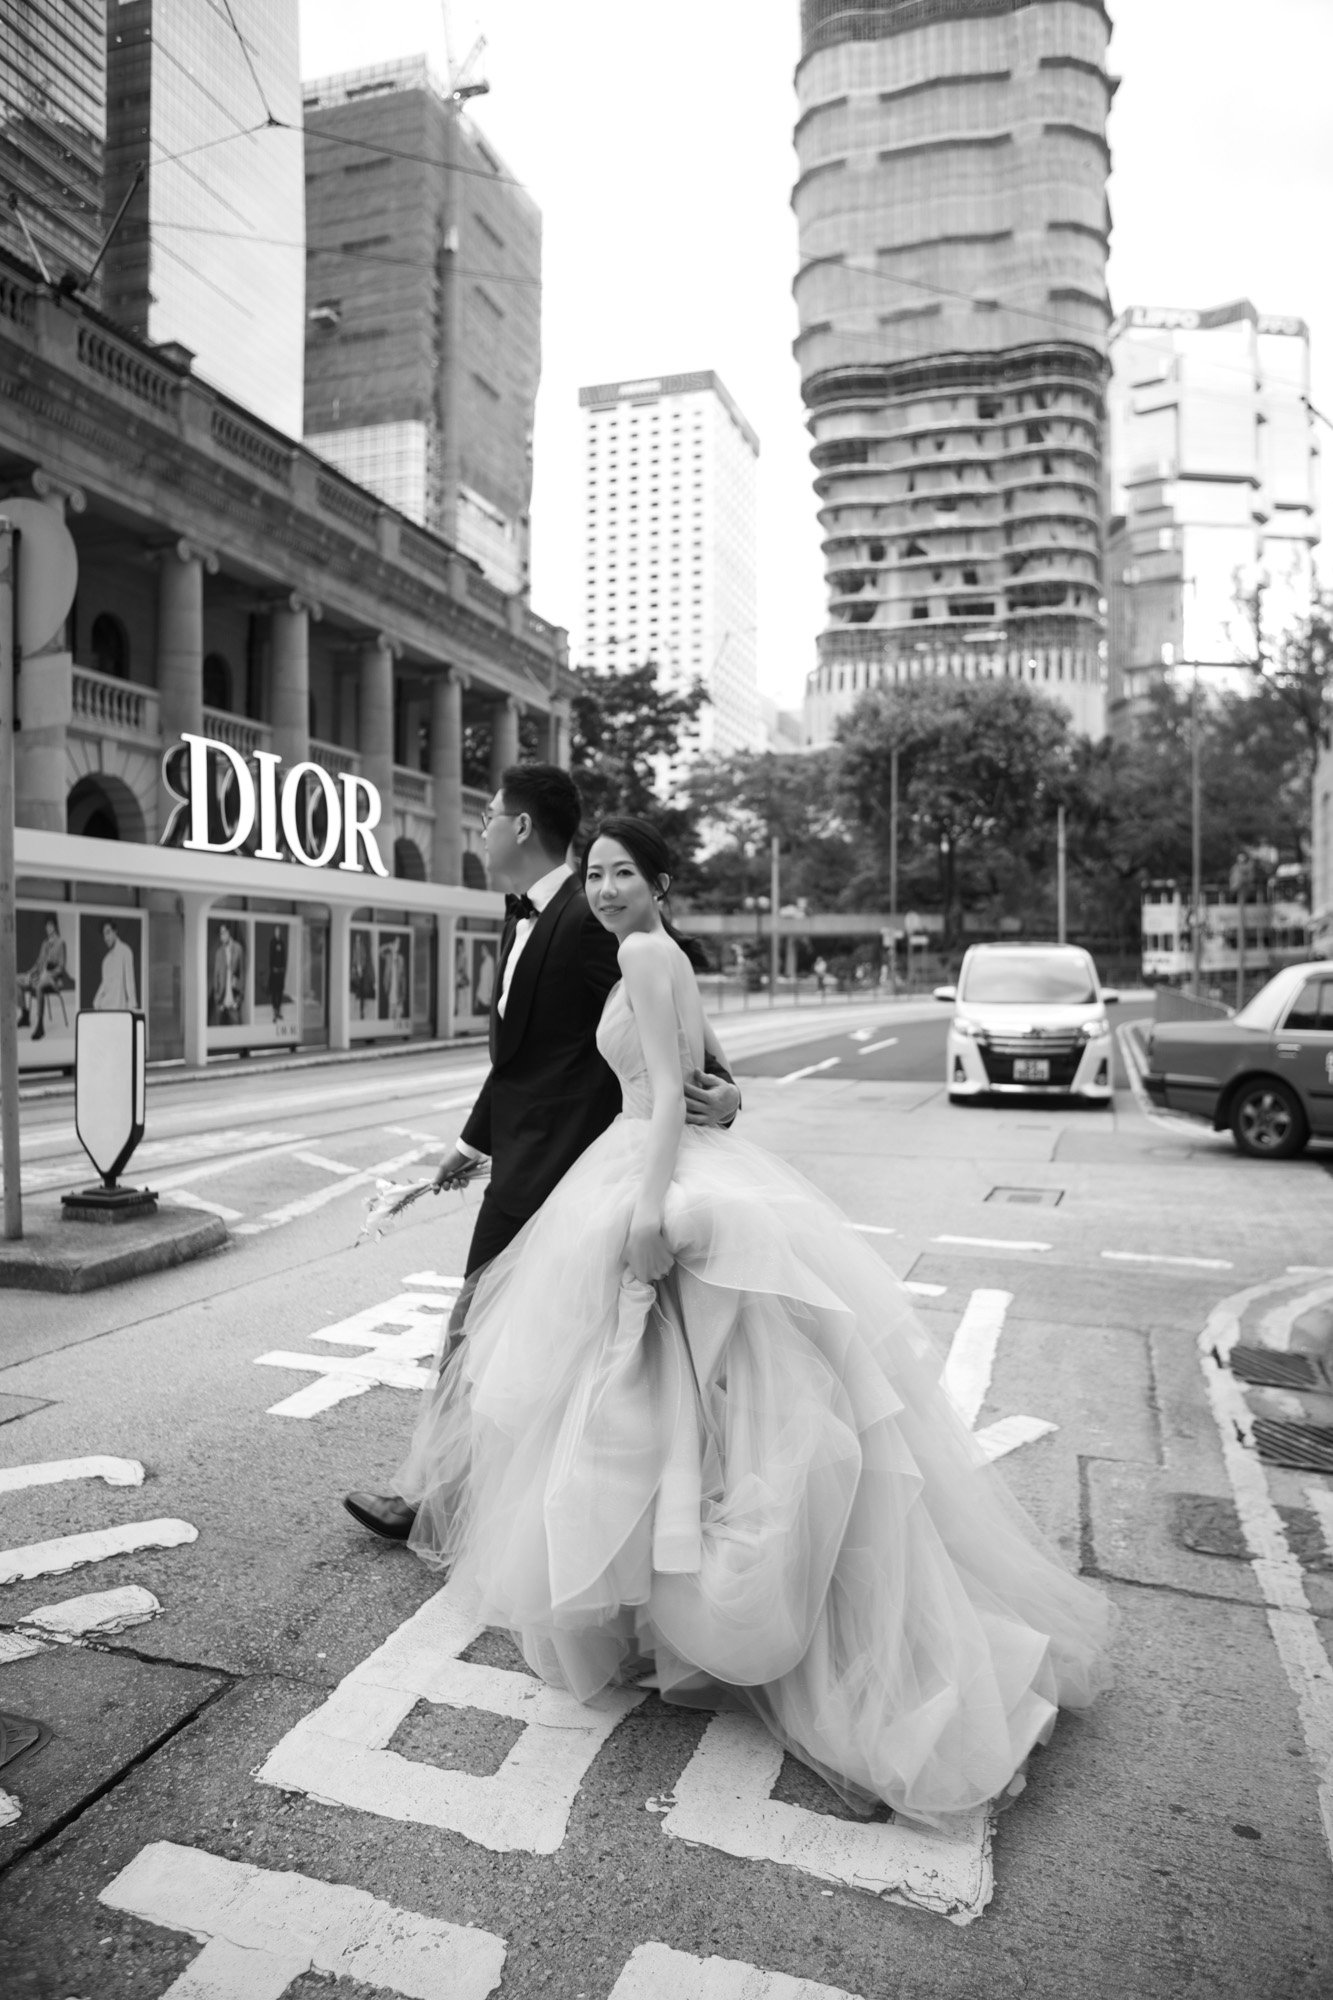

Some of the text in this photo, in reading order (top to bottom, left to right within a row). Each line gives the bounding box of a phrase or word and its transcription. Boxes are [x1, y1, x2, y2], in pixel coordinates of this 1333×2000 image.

[1132, 307, 1199, 330] LIPPO
[1257, 315, 1299, 335] PPO
[181, 732, 389, 877] DIOR
